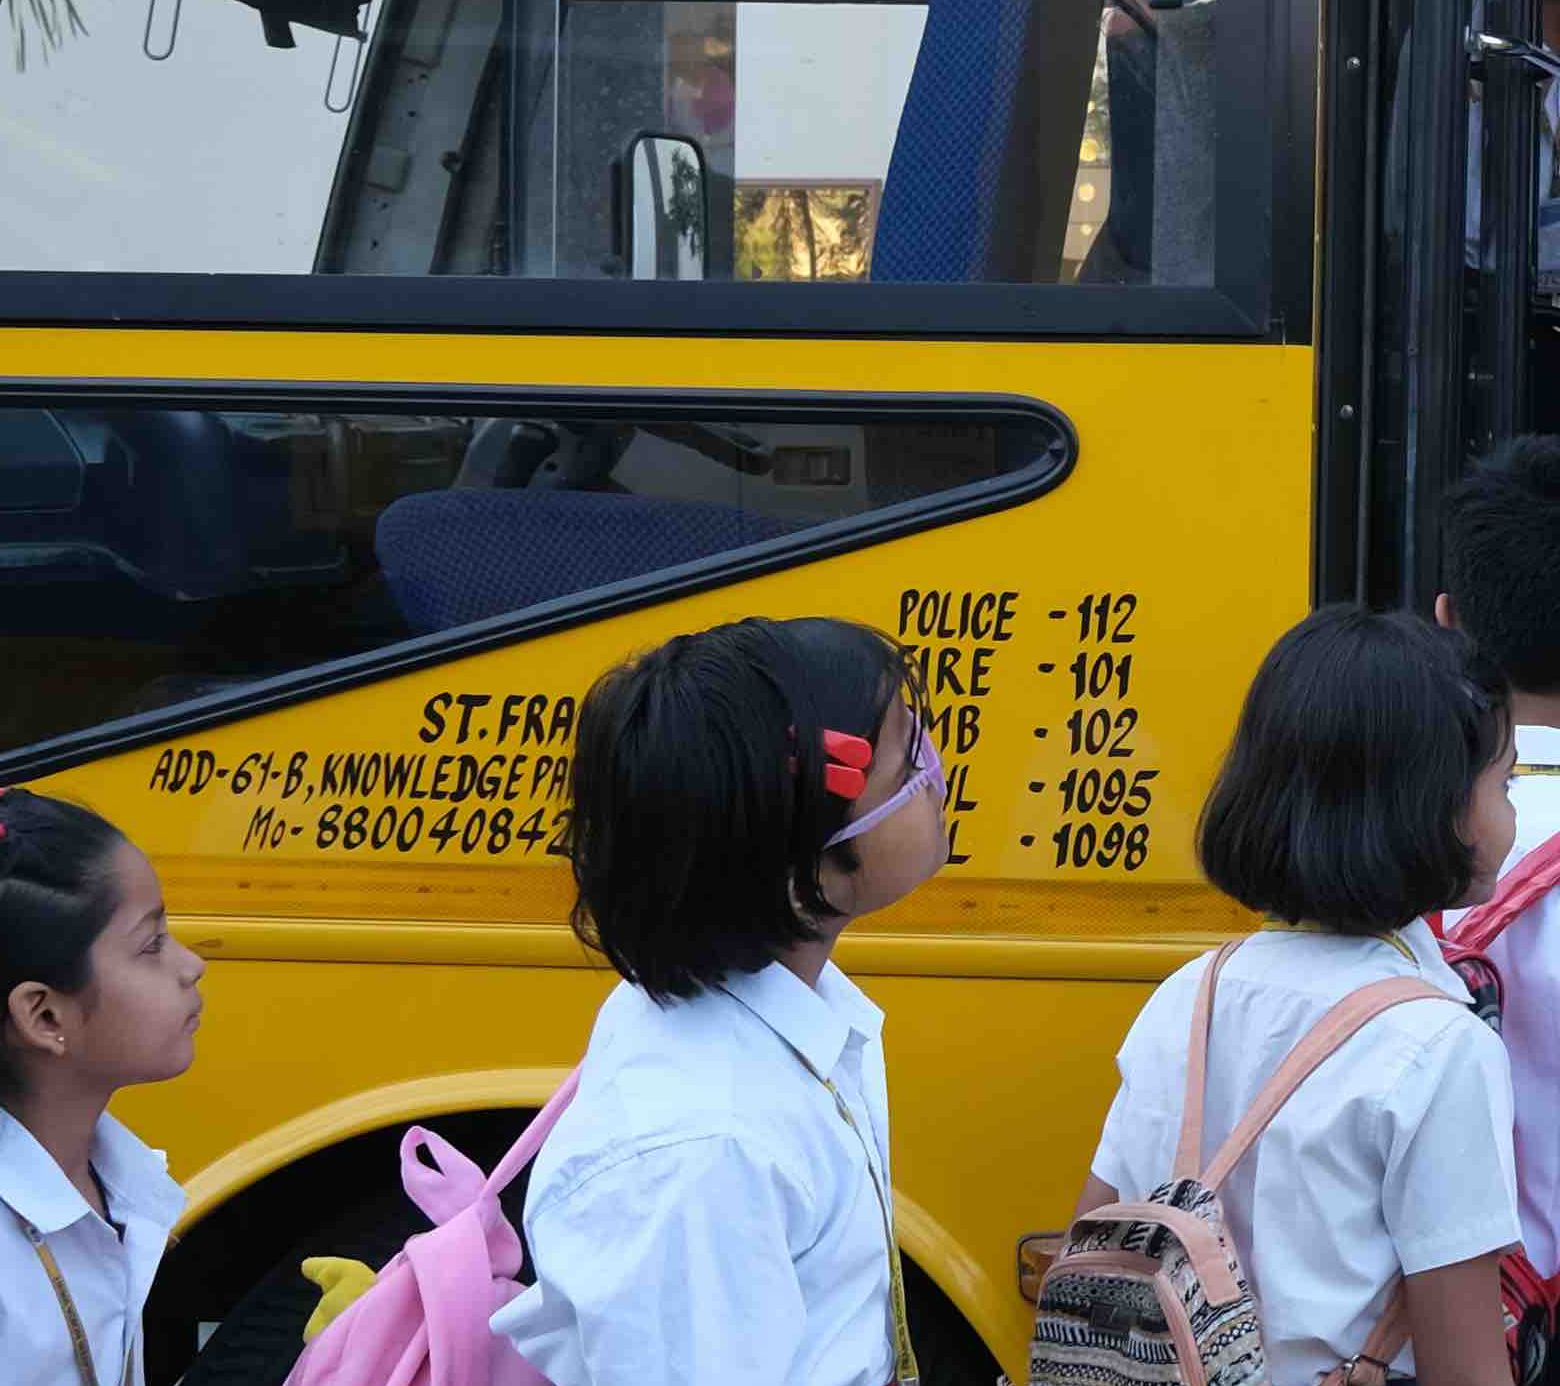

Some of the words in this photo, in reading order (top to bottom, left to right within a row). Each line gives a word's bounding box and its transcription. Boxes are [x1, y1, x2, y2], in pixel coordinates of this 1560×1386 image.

[898, 588, 1019, 642] POLICE
[1077, 592, 1138, 644] 112
[1069, 652, 1133, 701] 101
[927, 704, 981, 755] MB
[1066, 707, 1139, 758] 102
[1058, 768, 1161, 818] 1095
[316, 803, 573, 855] 880040842
[1052, 821, 1151, 872] 1098
